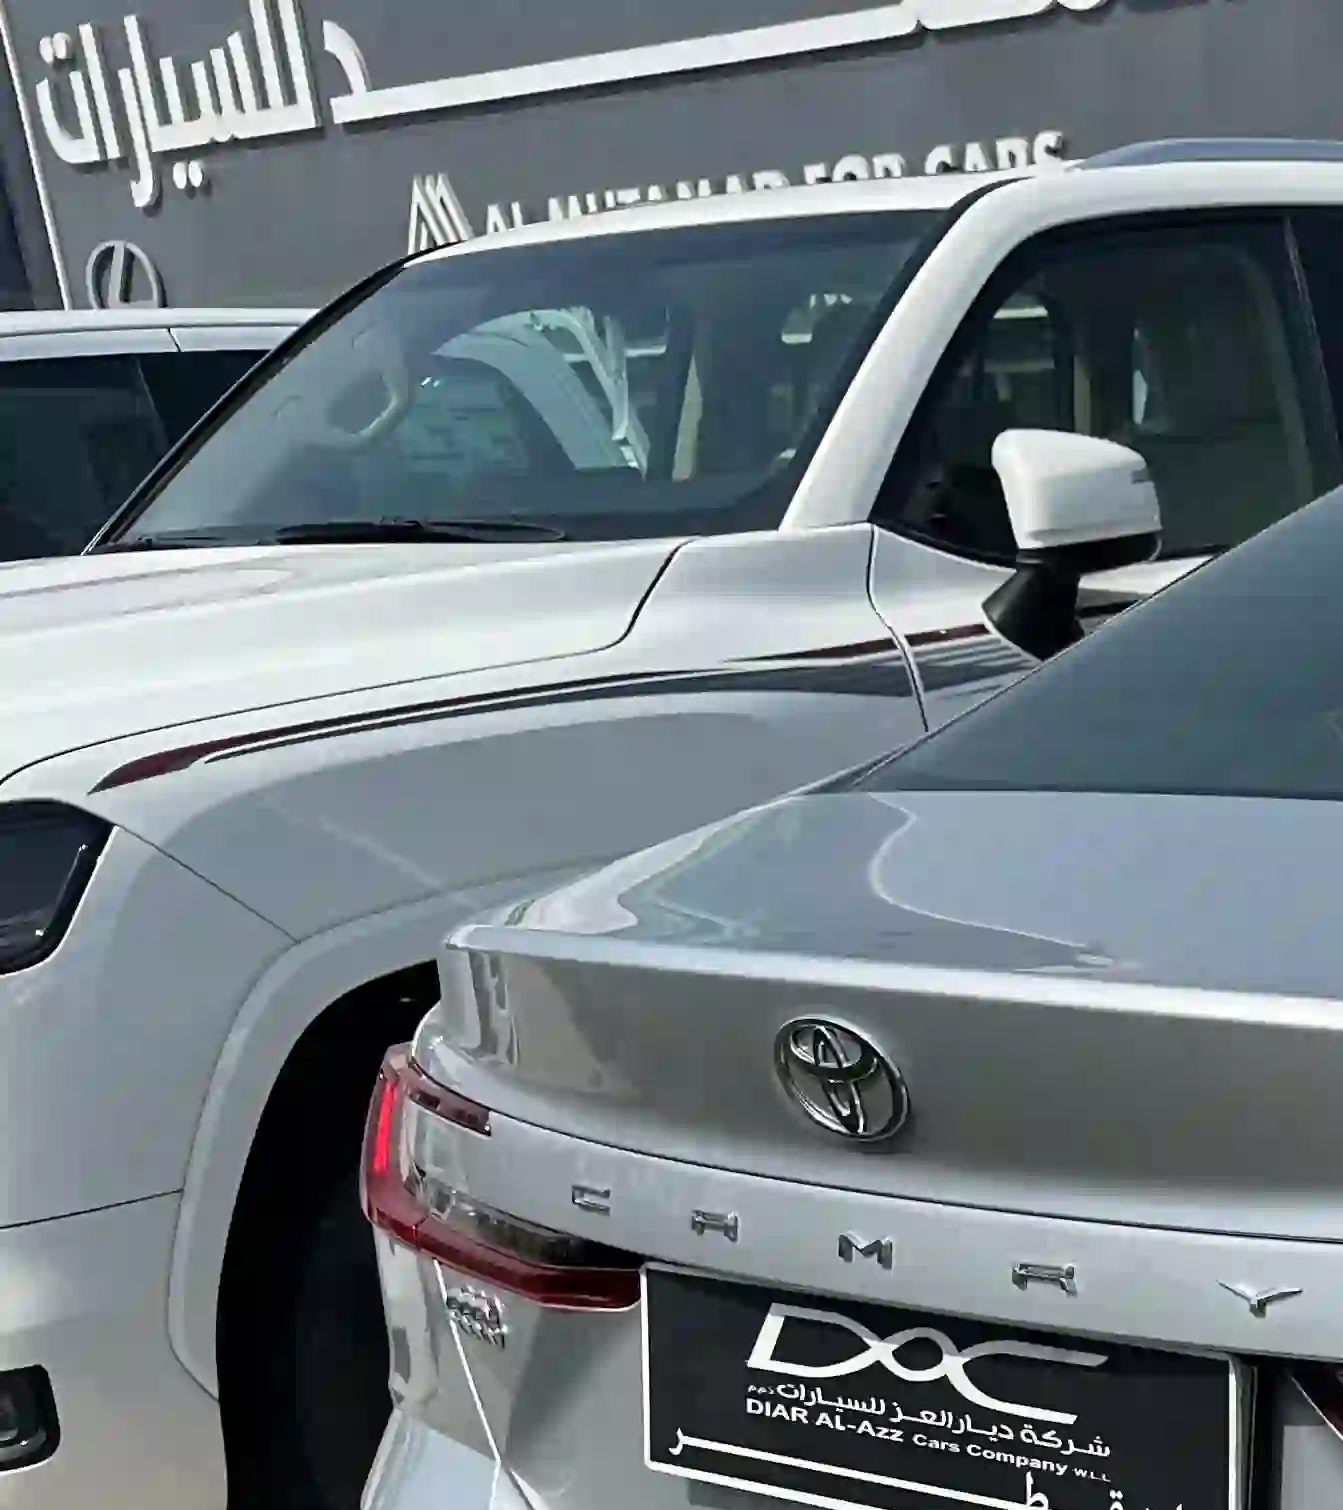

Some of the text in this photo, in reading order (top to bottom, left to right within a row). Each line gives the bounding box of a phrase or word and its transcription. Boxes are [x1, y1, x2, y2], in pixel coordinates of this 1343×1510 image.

[776, 1383, 886, 1416] للسيارات
[745, 1398, 809, 1425] DIAR
[911, 1432, 961, 1454] Cars
[966, 1443, 1069, 1478] Company
[1020, 1423, 1112, 1458] شركة
